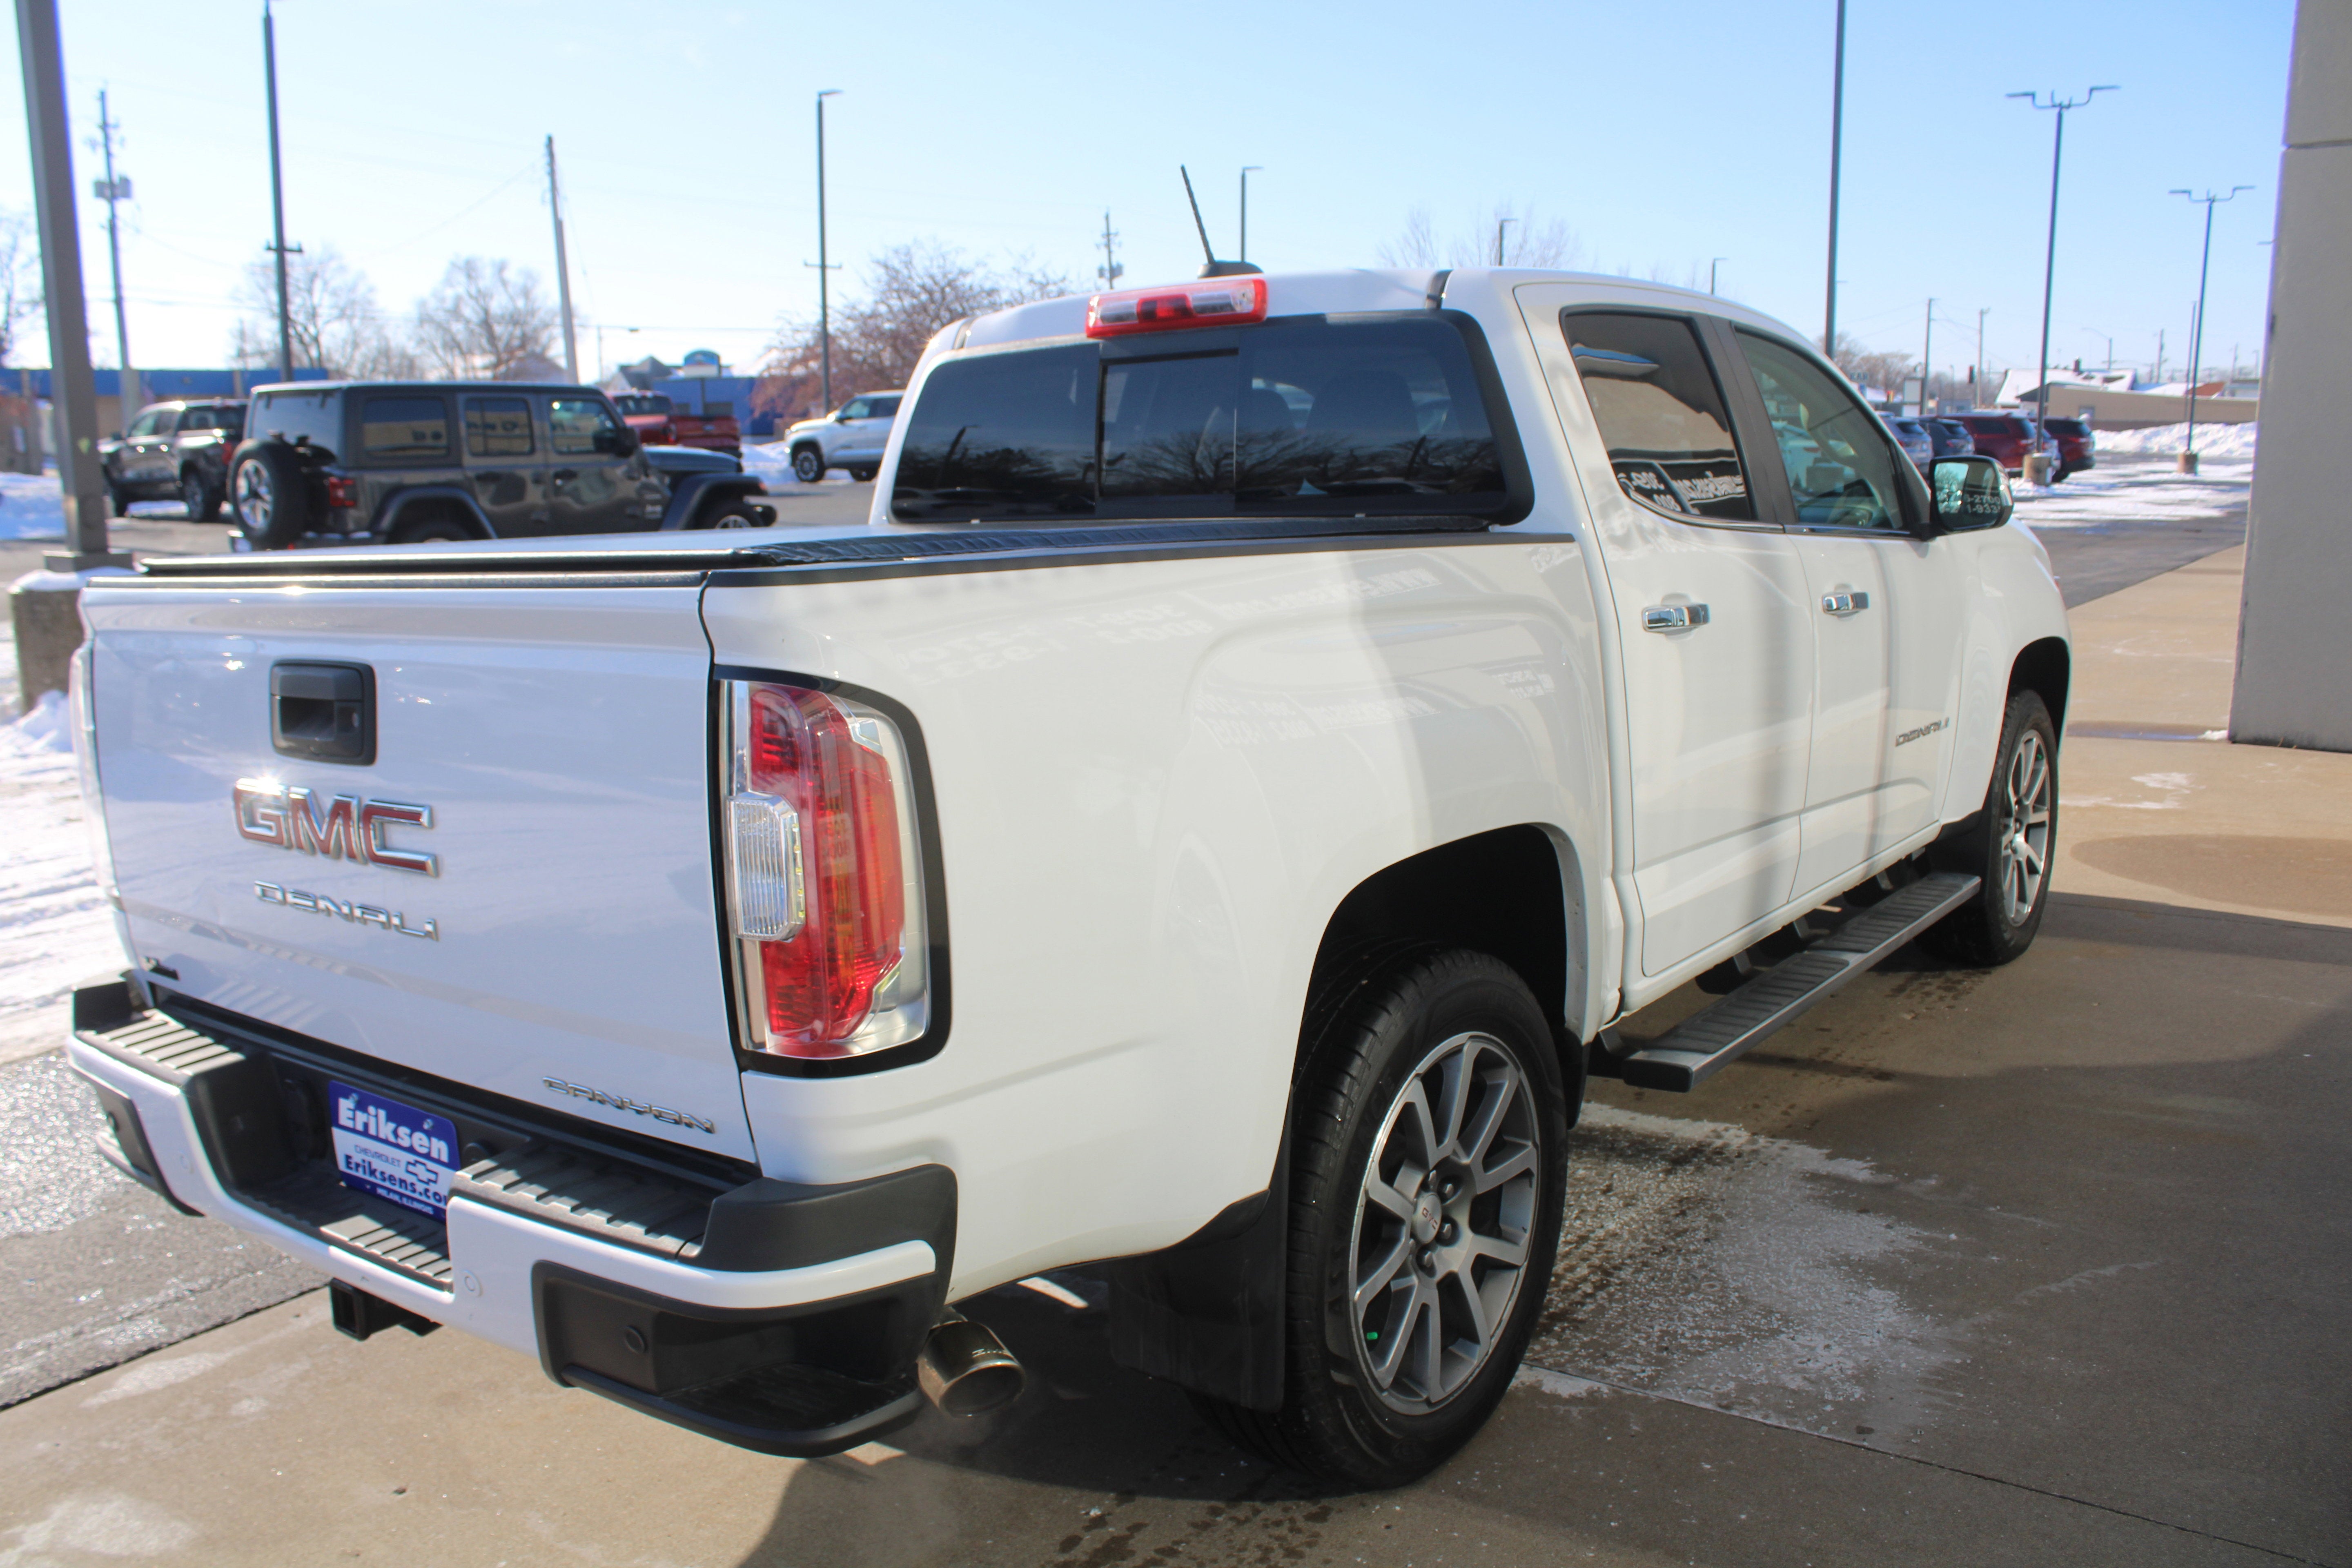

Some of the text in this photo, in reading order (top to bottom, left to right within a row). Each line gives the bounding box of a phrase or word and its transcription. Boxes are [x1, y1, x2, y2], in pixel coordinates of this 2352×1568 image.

[1895, 717, 1949, 747] DENALI
[234, 778, 439, 877] GMC
[255, 880, 439, 941] DENALI
[338, 1097, 449, 1163] Eriksen
[542, 1076, 715, 1134] CANYON
[354, 1145, 401, 1168] CHEVROLET
[1422, 1207, 1438, 1230] GMC
